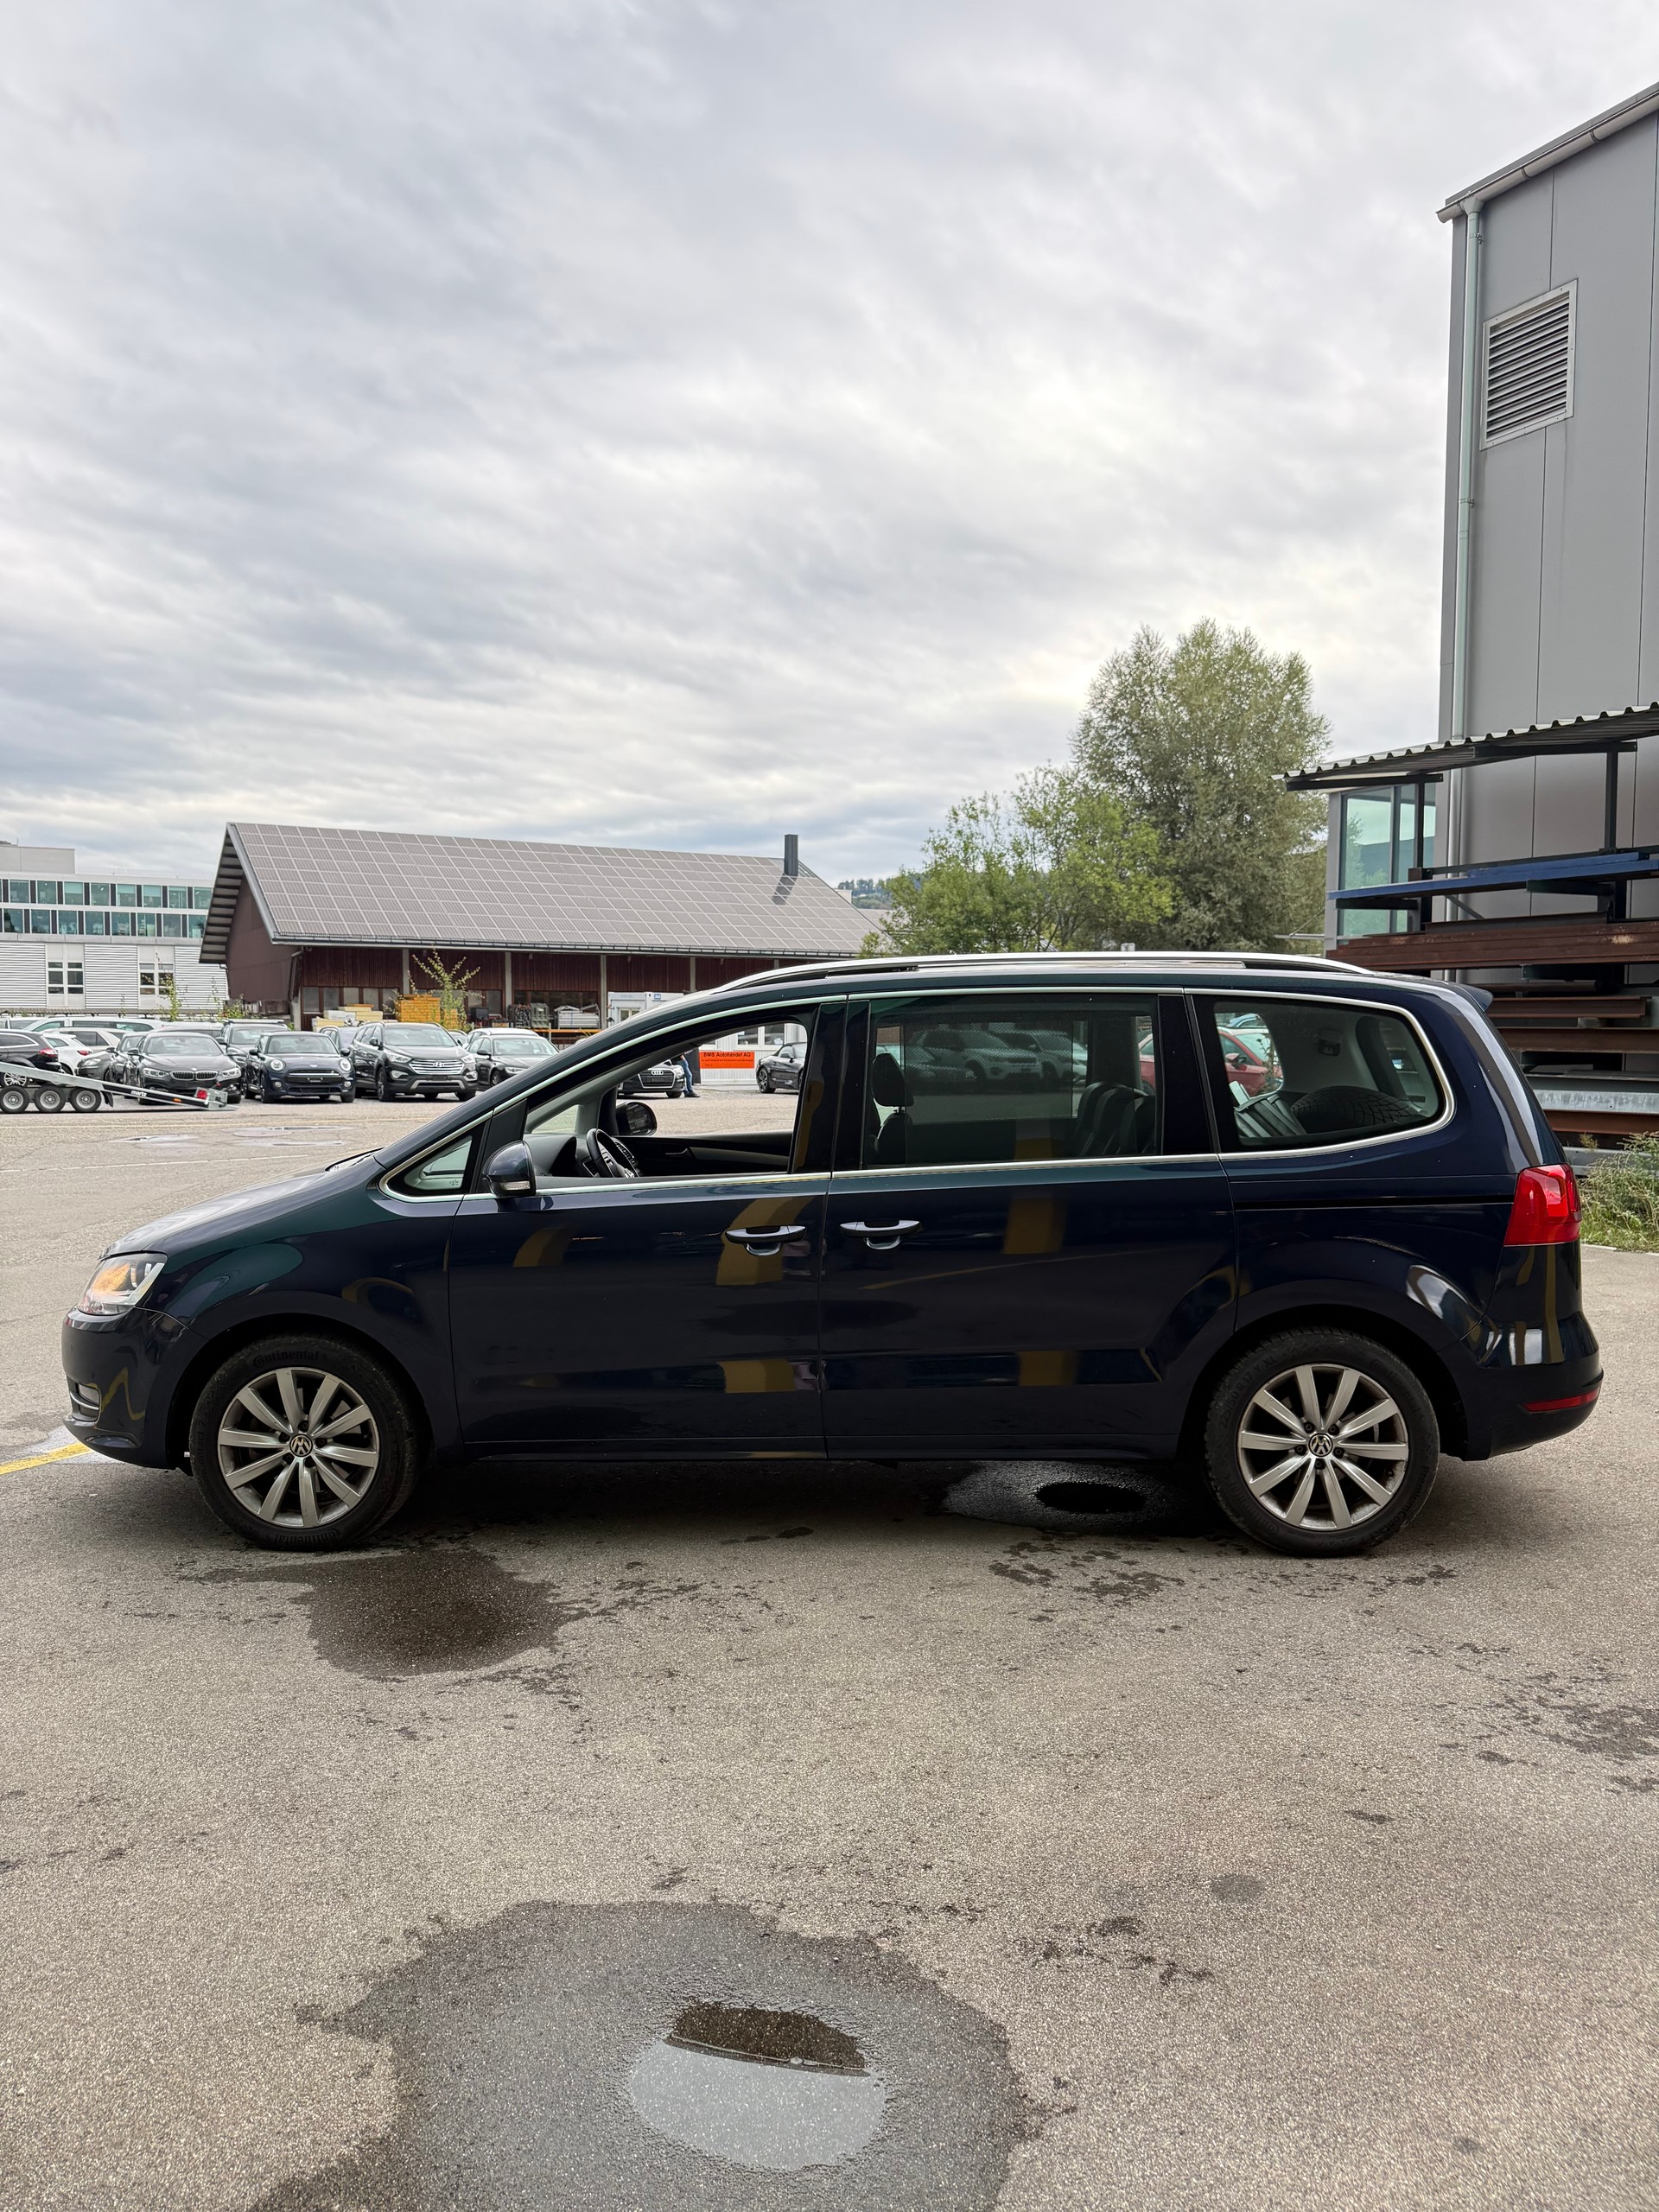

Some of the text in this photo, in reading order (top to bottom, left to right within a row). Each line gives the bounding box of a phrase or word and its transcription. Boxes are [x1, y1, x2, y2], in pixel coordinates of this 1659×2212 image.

[252, 1350, 319, 1368] Continental
[1218, 1387, 1241, 1428] 225/50
[1370, 1465, 1430, 1540] PremiumContact
